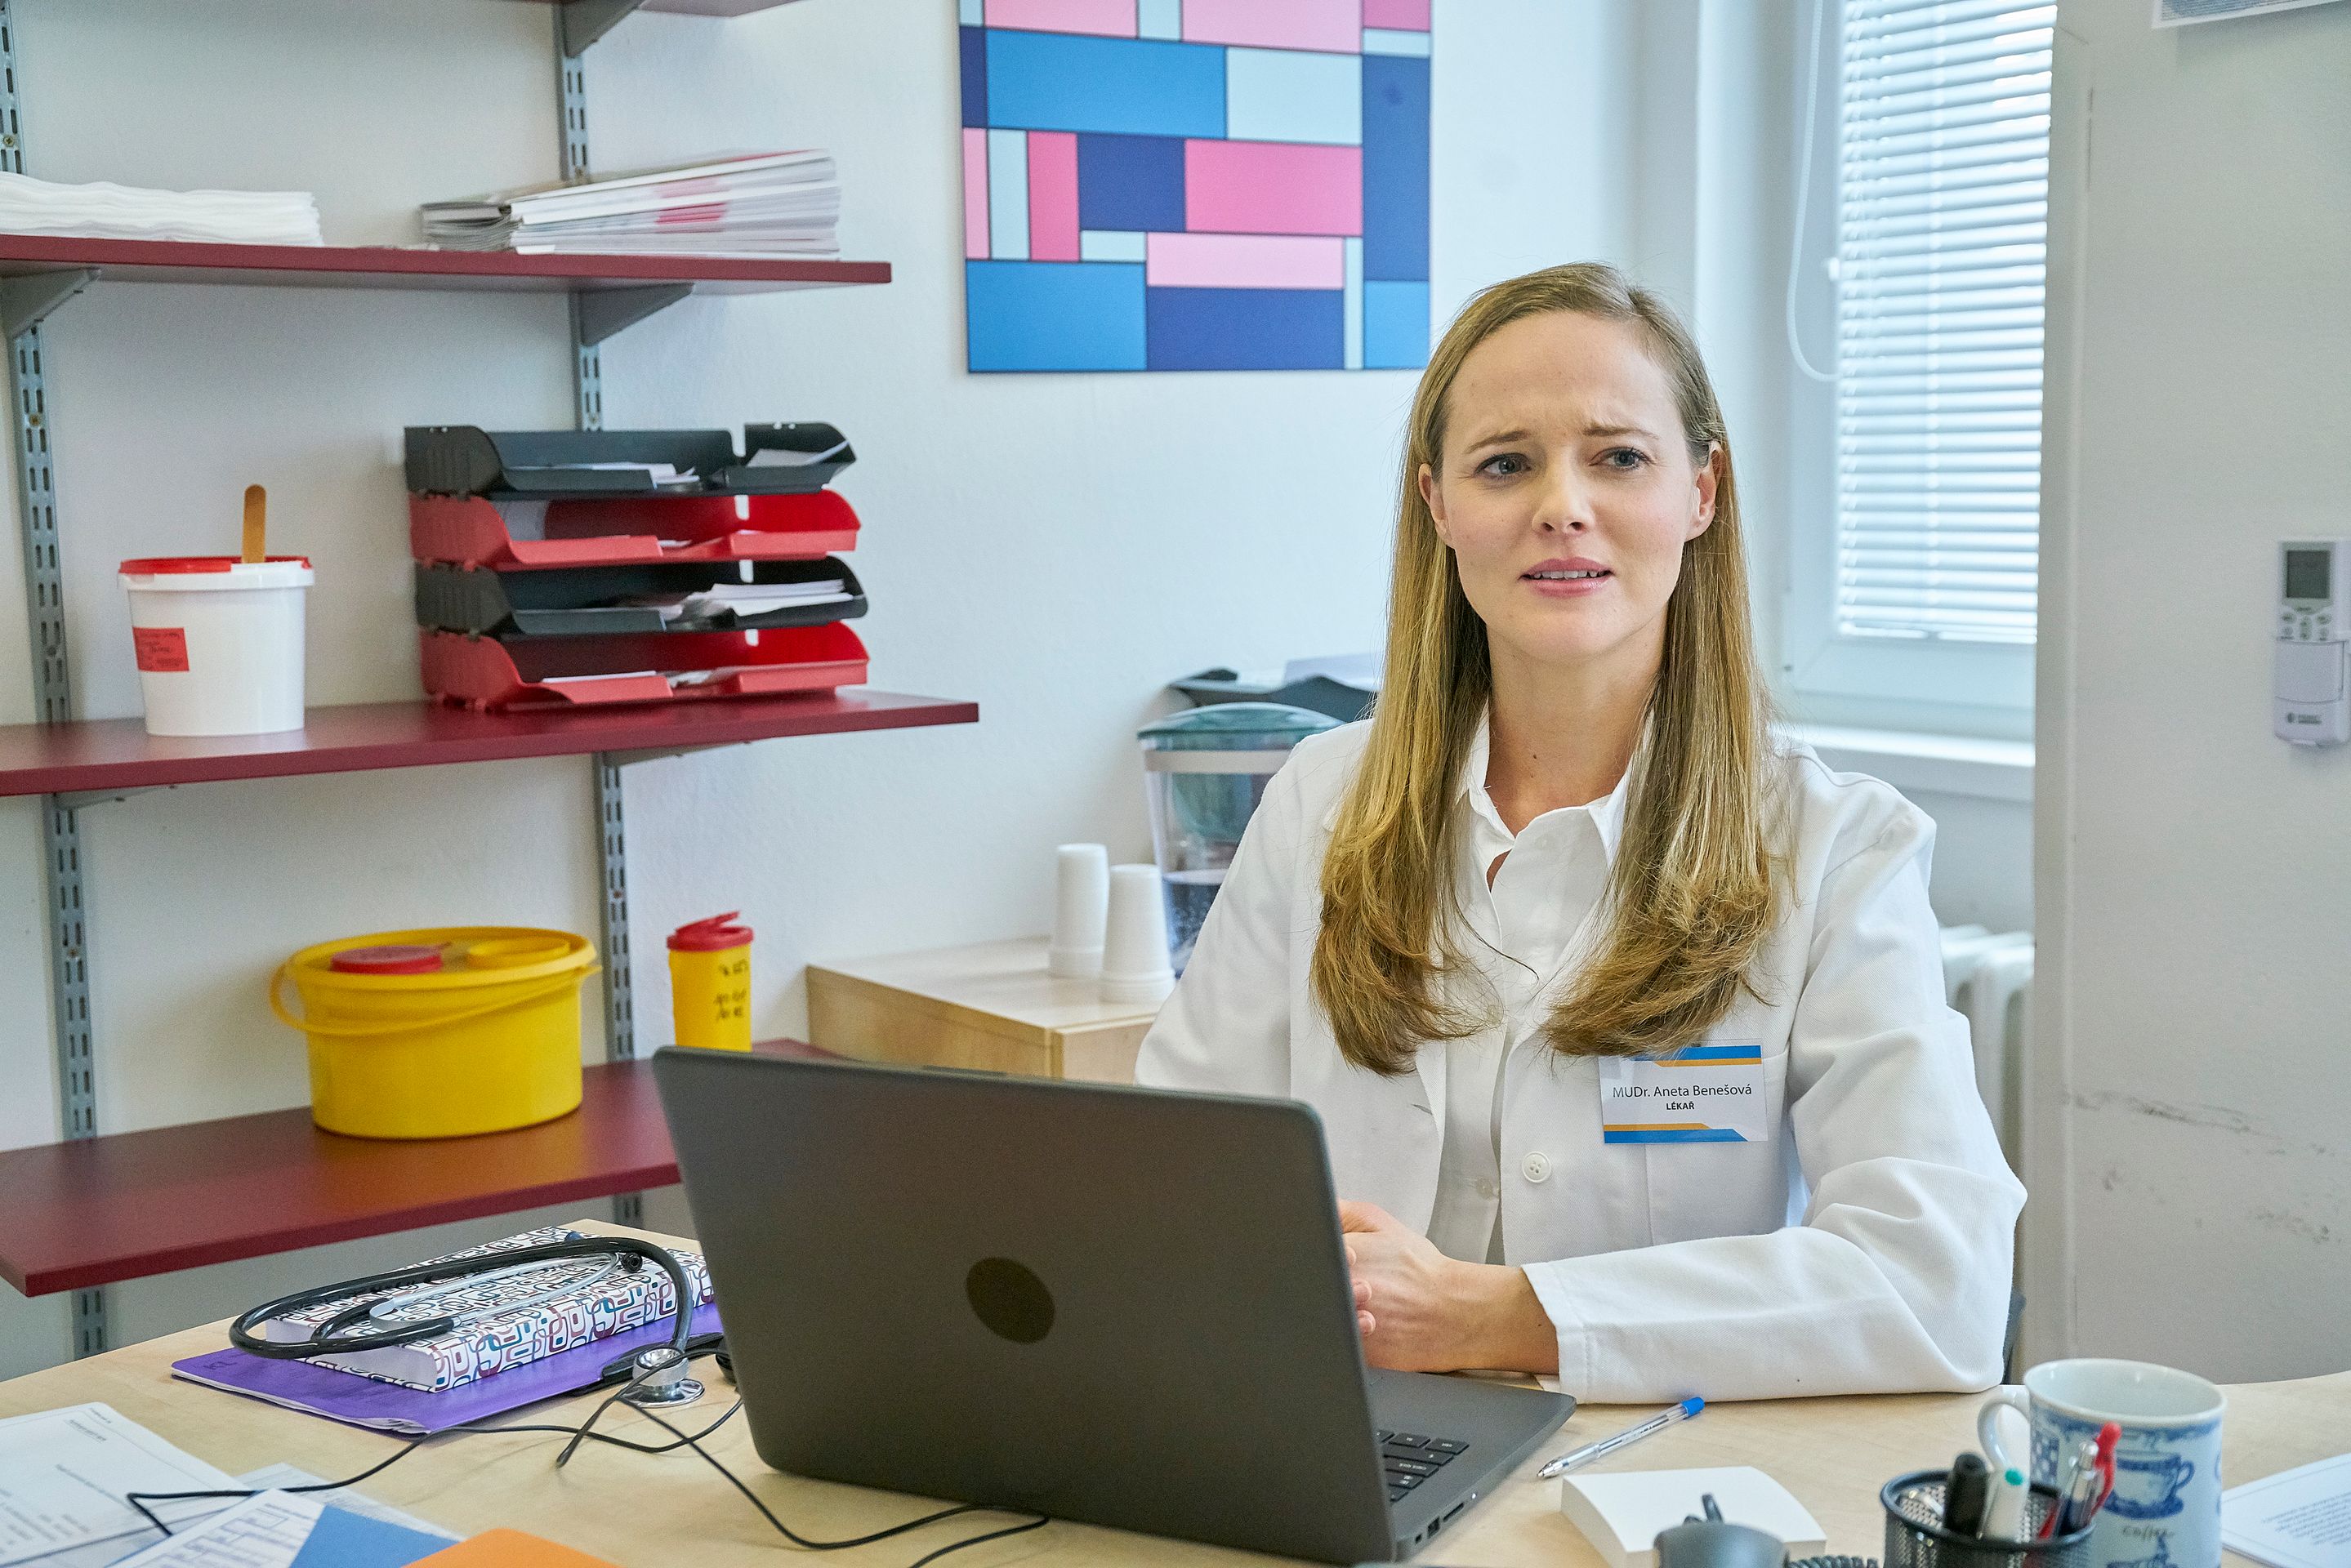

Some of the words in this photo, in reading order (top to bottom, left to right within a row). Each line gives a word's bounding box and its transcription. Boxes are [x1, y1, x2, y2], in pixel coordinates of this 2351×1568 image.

[1613, 1086, 1650, 1098] MUDr.
[1654, 1086, 1689, 1097] Aneta
[1693, 1083, 1752, 1096] Benešová
[1666, 1102, 1695, 1111] LÉKAŘ
